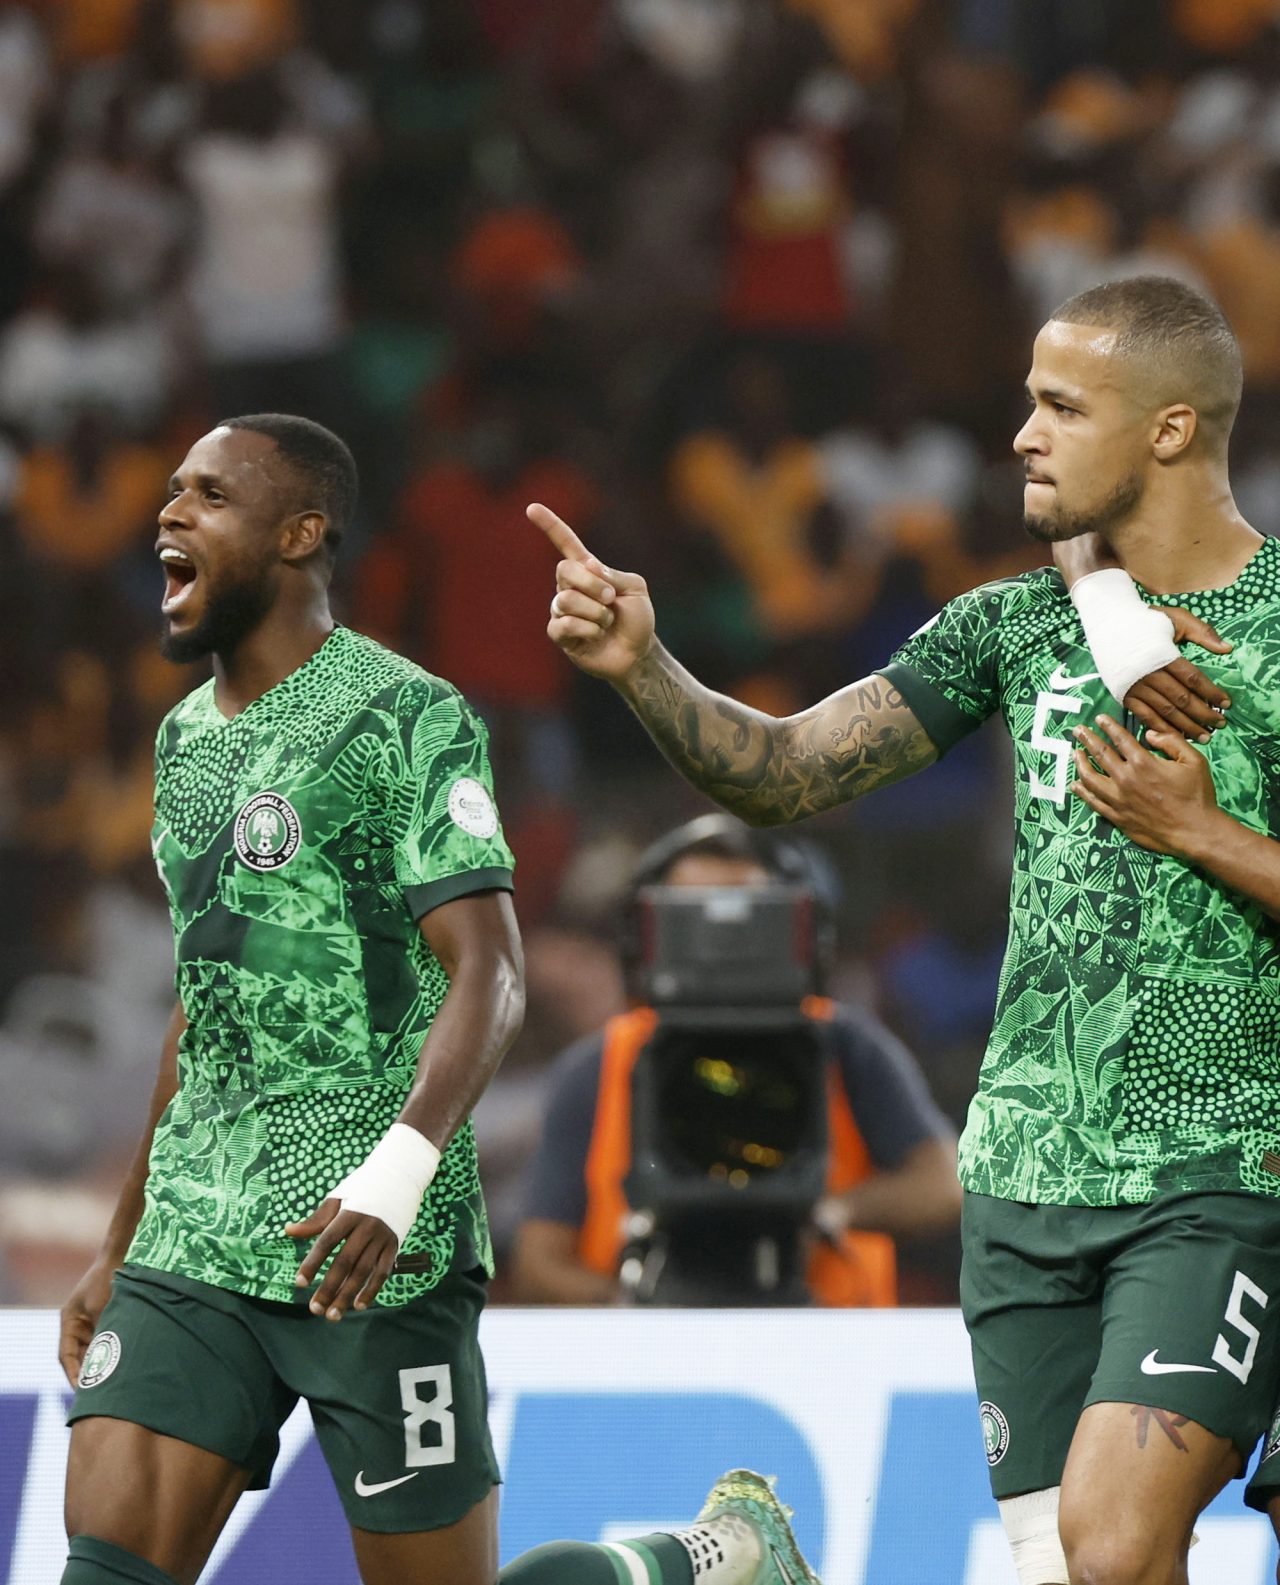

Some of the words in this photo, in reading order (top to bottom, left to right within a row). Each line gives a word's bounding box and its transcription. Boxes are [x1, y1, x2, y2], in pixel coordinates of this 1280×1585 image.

[1028, 691, 1083, 805] 5
[243, 796, 280, 819] FOOTBALL
[278, 803, 298, 858] FEDERATION
[256, 857, 276, 866] 1945
[1211, 1270, 1269, 1385] 5
[399, 1363, 456, 1468] 8
